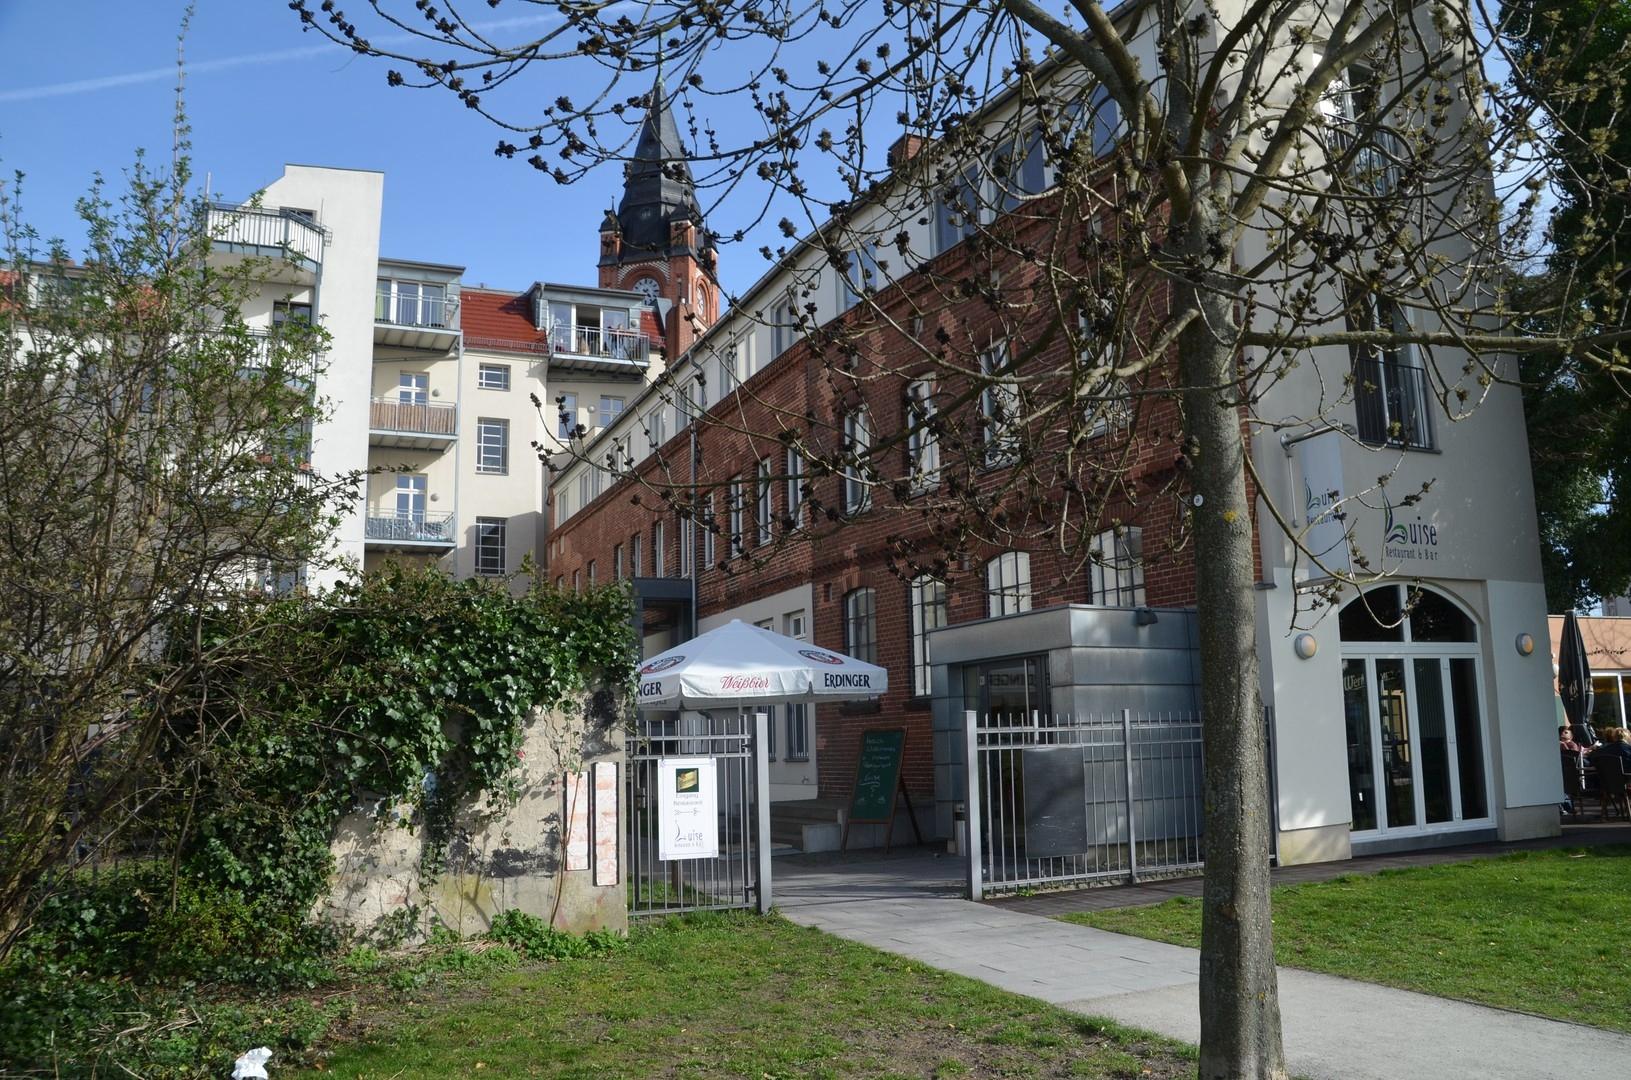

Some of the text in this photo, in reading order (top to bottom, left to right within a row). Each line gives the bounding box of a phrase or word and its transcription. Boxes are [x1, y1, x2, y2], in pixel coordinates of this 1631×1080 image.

[1380, 487, 1438, 546] Luise
[1385, 546, 1416, 559] Restaurant
[1425, 549, 1438, 560] Bar
[824, 673, 871, 688] ERDINGER
[636, 681, 662, 698] NGER
[675, 819, 703, 841] Luise
